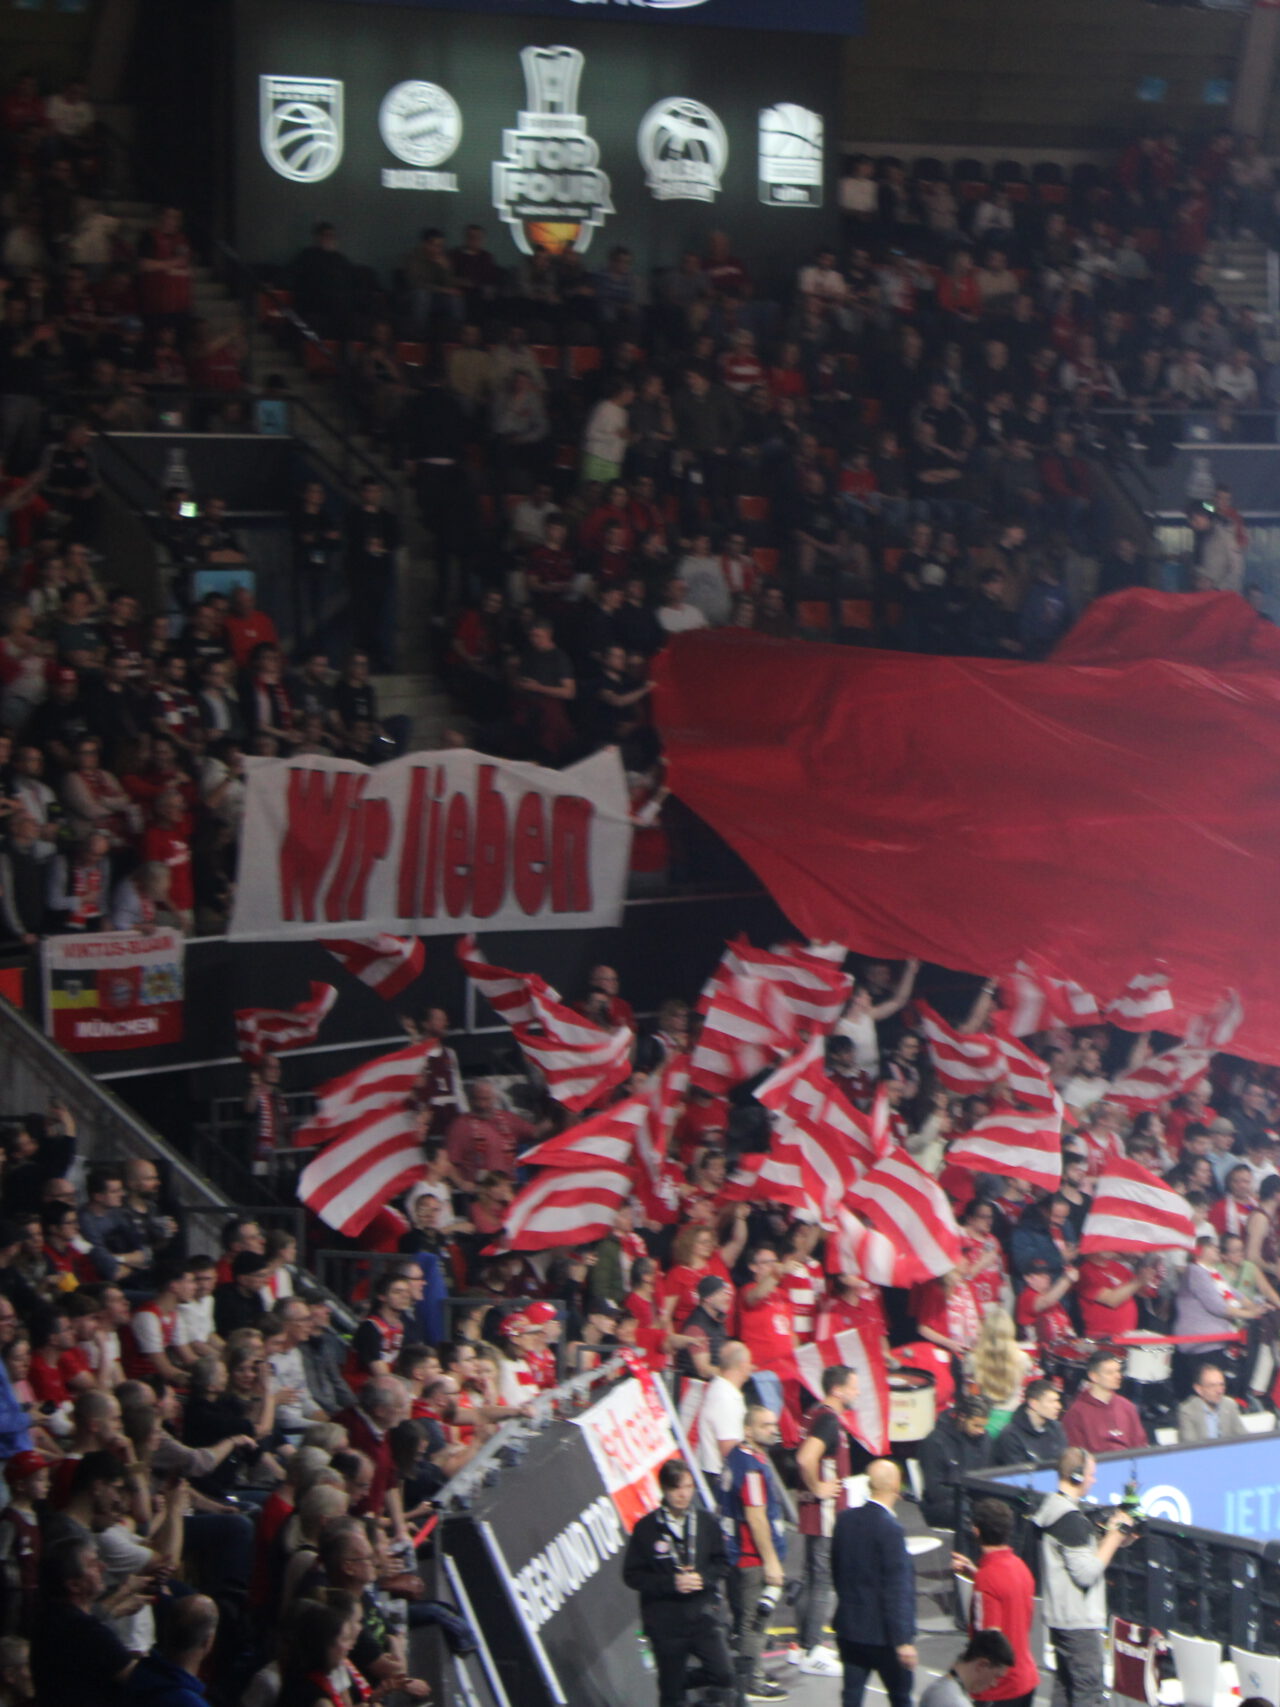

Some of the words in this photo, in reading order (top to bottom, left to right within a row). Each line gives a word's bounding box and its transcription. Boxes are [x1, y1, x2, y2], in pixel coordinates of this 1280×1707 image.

[504, 171, 604, 204] FOUR
[515, 138, 593, 170] TOP
[280, 766, 391, 922] Wir
[396, 763, 594, 919] lieben
[512, 1520, 600, 1634] SIEGMUND
